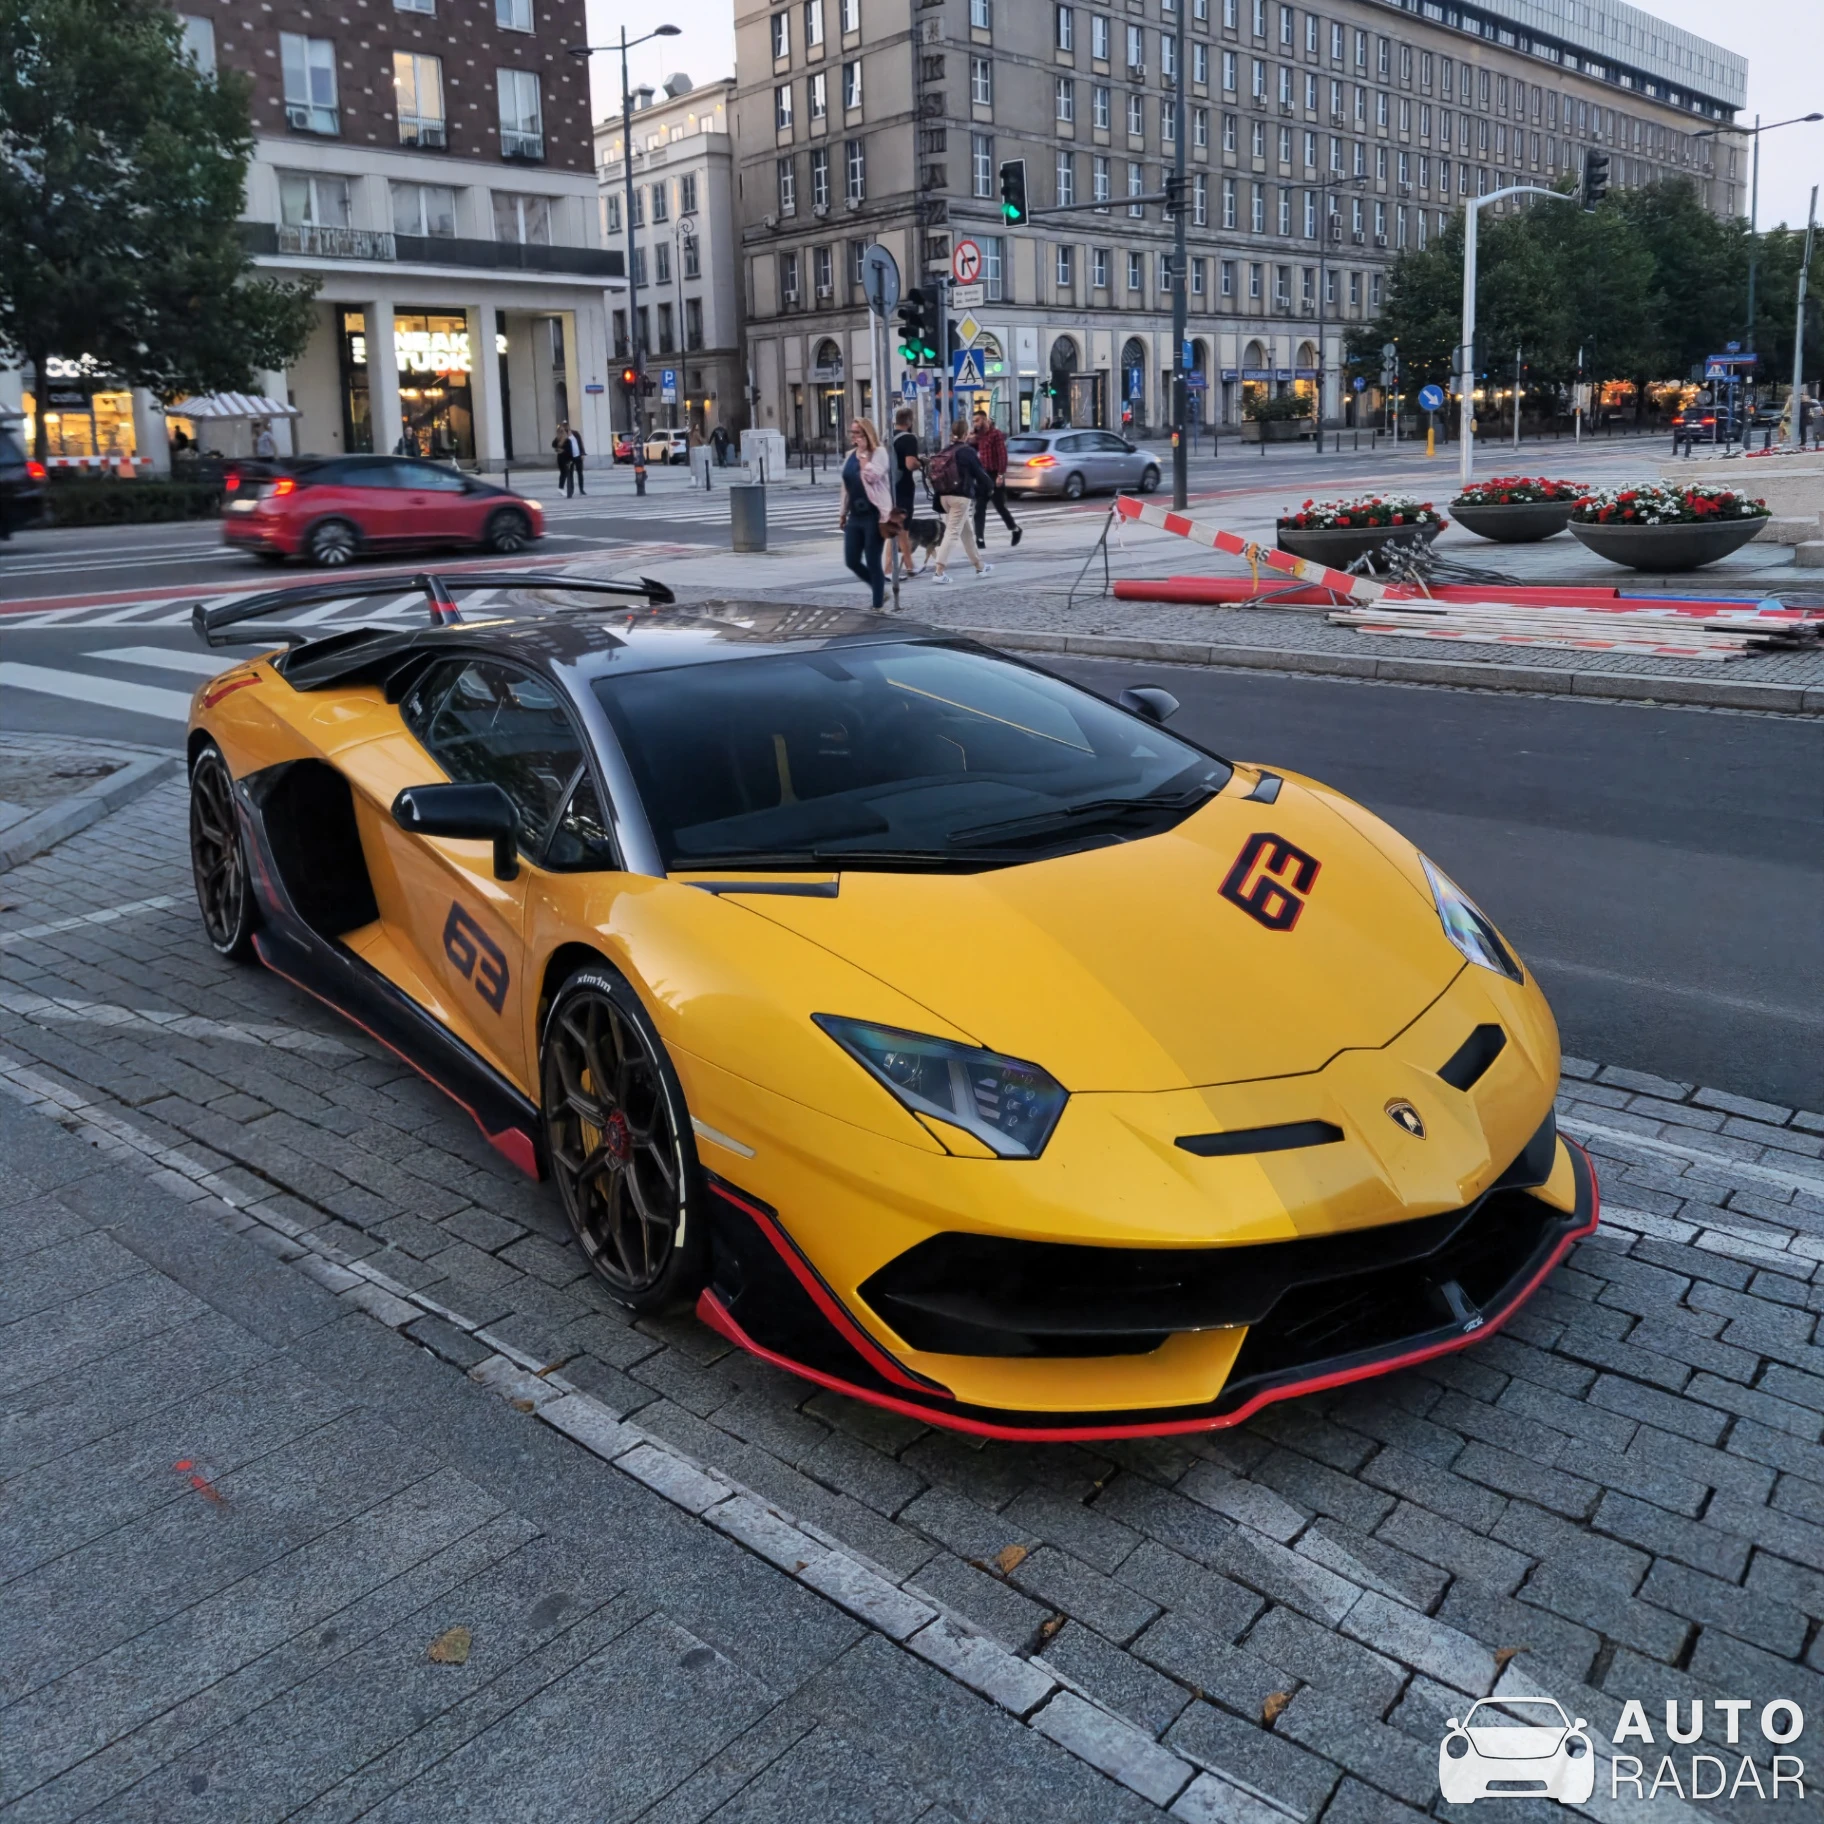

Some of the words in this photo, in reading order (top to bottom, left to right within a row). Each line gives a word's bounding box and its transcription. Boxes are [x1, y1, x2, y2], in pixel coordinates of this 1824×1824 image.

[395, 351, 472, 371] TUDIO
[665, 371, 674, 384] P
[1216, 832, 1323, 933] 63
[442, 898, 511, 1018] 63
